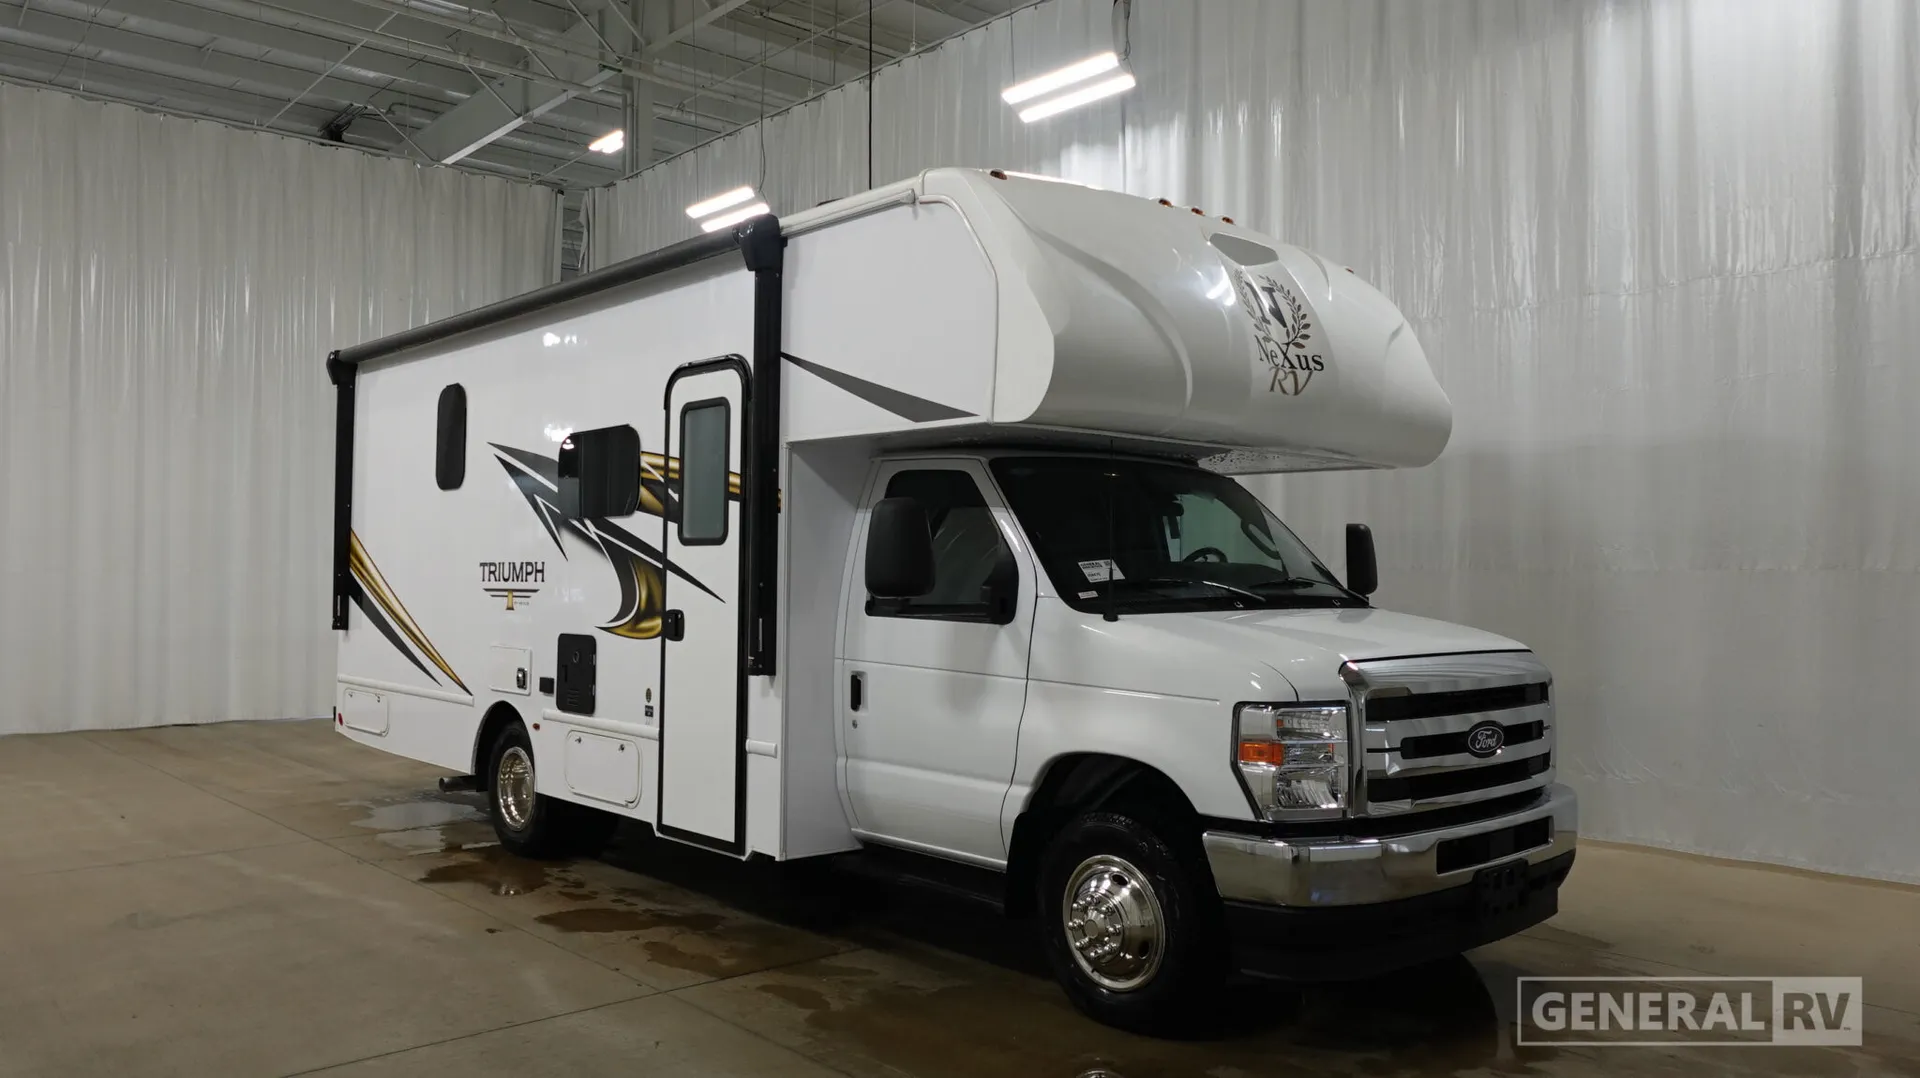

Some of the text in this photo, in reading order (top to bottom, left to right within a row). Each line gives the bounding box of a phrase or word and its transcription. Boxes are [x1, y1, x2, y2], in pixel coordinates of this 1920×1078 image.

[1269, 366, 1313, 396] RV
[479, 561, 545, 583] TRIUMPH
[1475, 730, 1498, 749] Ford
